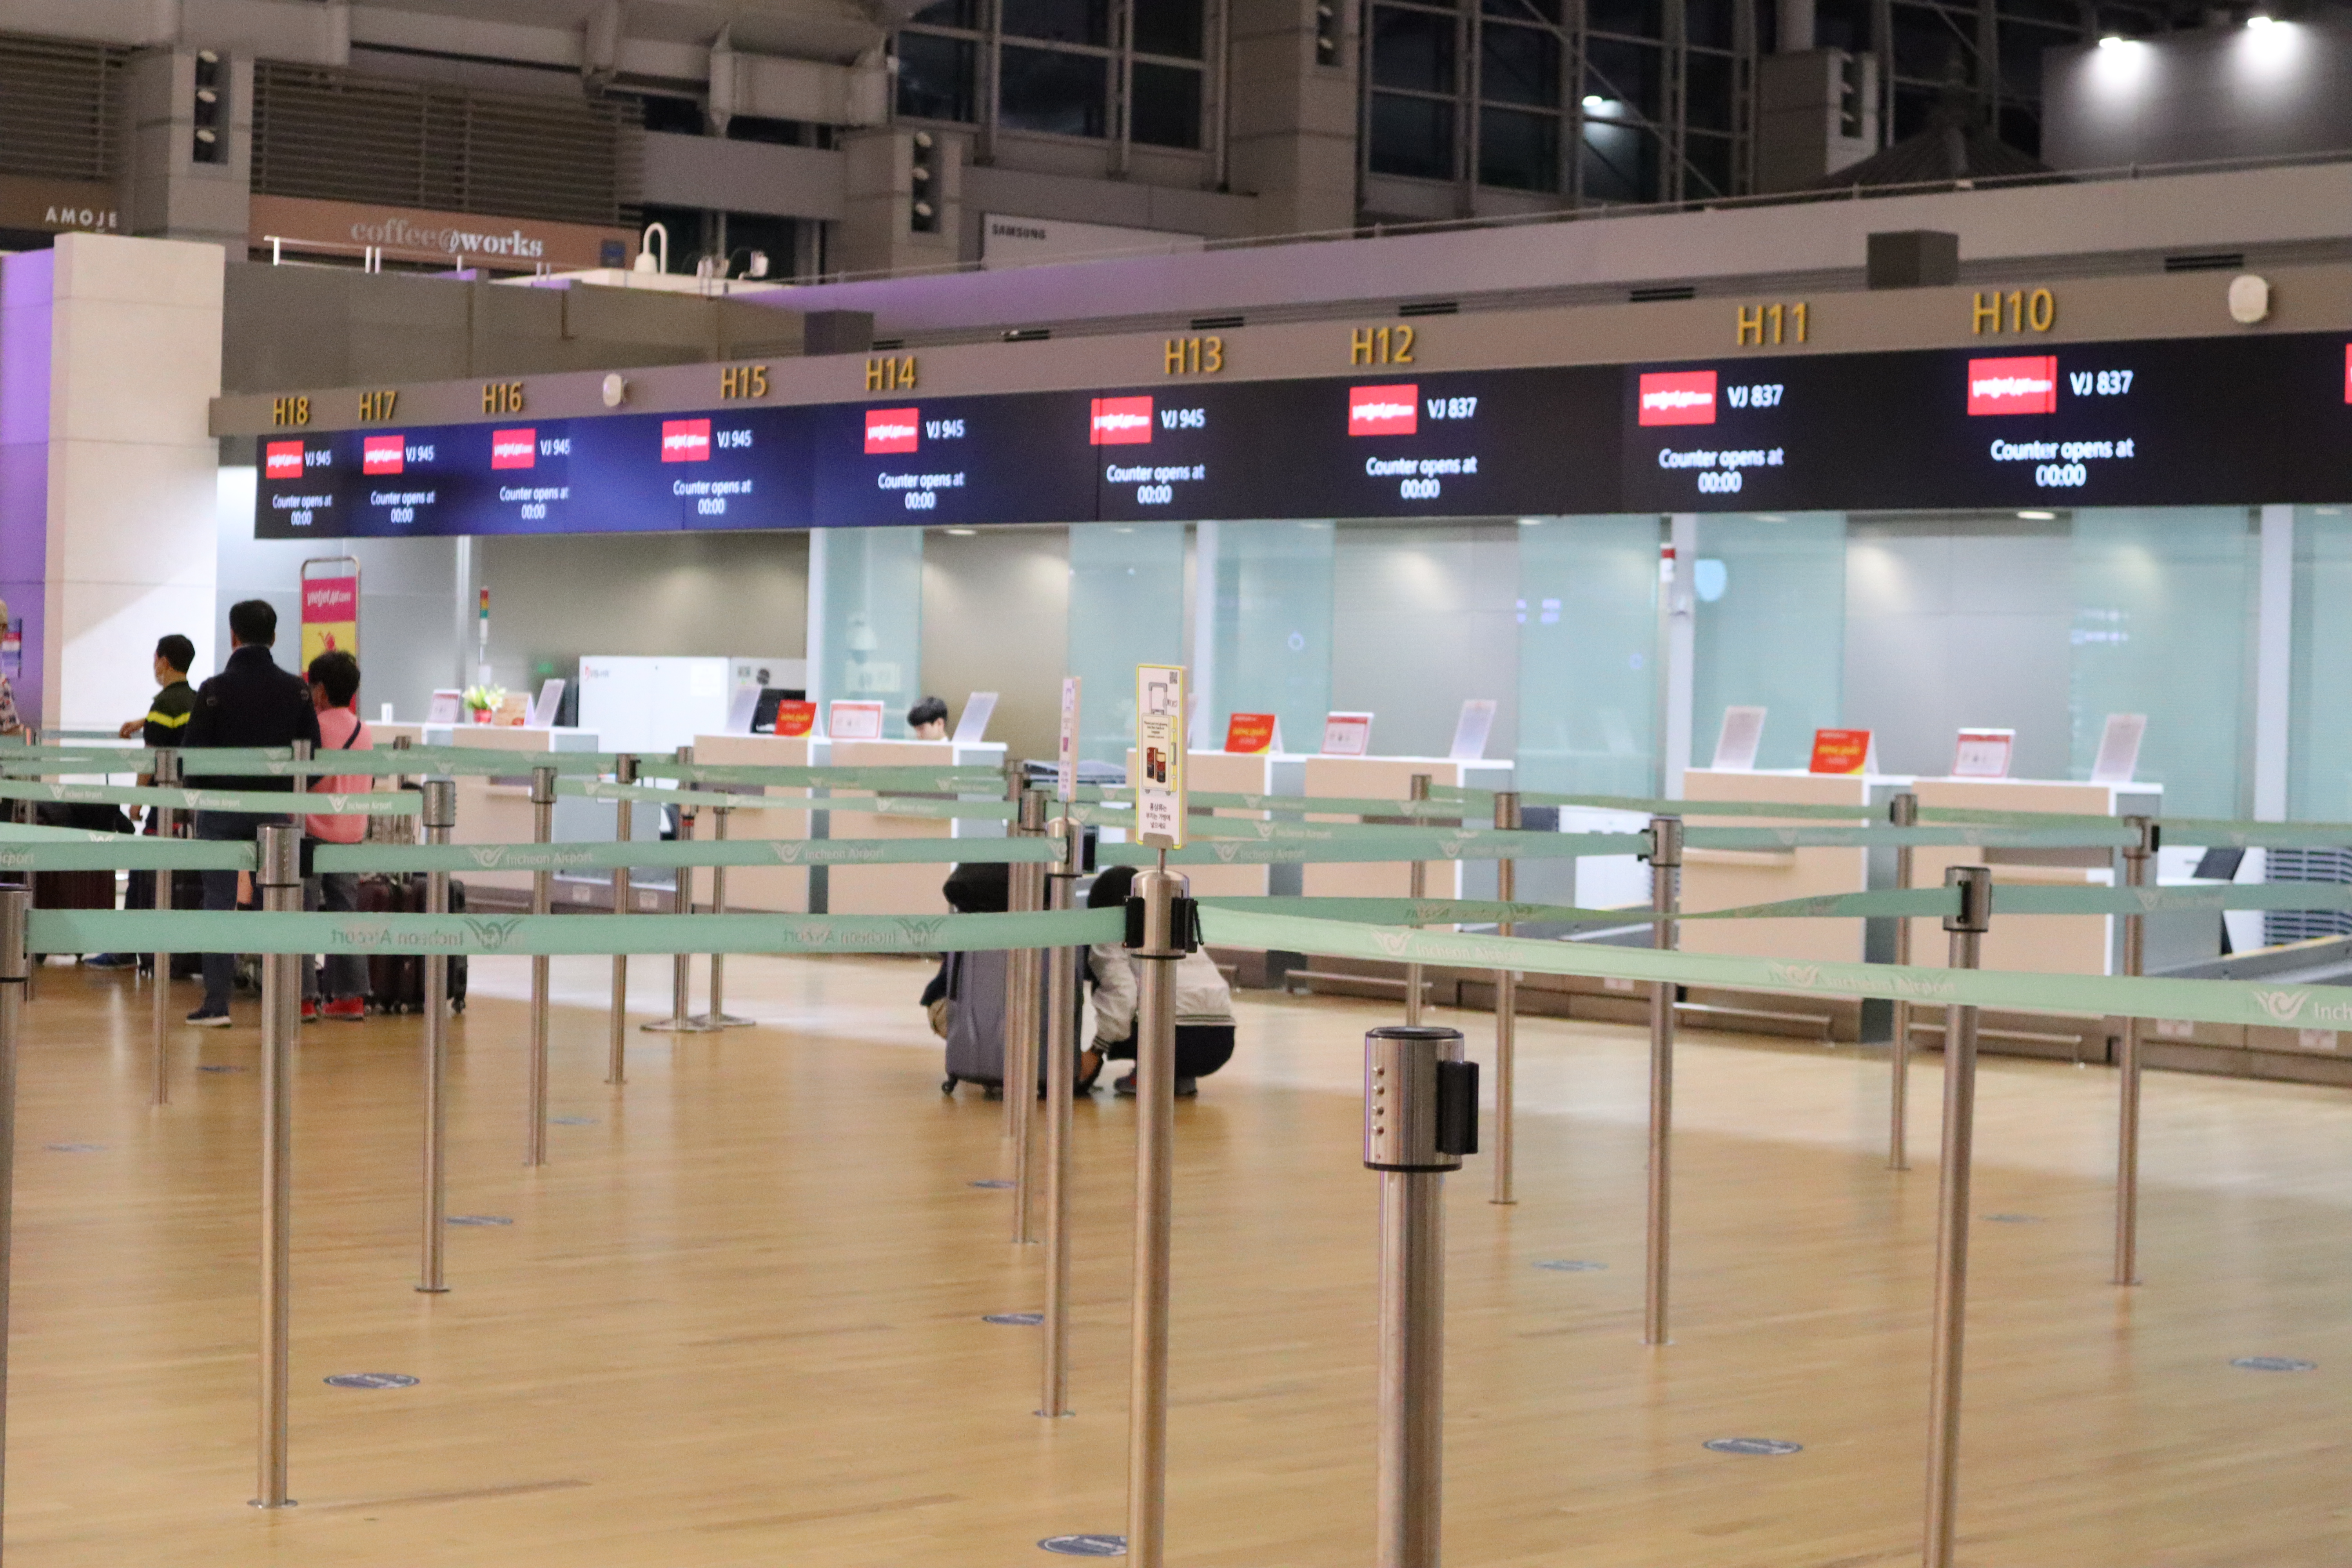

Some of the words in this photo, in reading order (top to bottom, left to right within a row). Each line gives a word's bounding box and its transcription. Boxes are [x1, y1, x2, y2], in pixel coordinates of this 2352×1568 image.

[45, 206, 117, 228] AMOJE
[1974, 289, 2053, 333] H10
[1739, 302, 1808, 344] H11
[1352, 325, 1413, 363] H12
[1165, 337, 1221, 373] H13
[721, 366, 767, 397] H15
[866, 356, 915, 389] H14
[2070, 372, 2092, 395] VJ
[2097, 371, 2132, 394] 837
[359, 391, 396, 419] H17
[483, 383, 522, 412] H16
[1728, 387, 1748, 407] VJ
[1751, 385, 1783, 406] 837
[274, 397, 308, 424] H18
[1428, 399, 1445, 418] VJ
[1448, 397, 1477, 418] 837
[1161, 410, 1177, 428] VJ
[1180, 409, 1204, 428] 945
[926, 421, 940, 438] VJ
[942, 420, 964, 438] 945
[541, 441, 552, 455] VJ
[554, 439, 570, 455] 945
[717, 432, 730, 447] VJ
[732, 430, 751, 447] 945
[305, 452, 315, 466] VJ
[316, 451, 331, 466] 945
[406, 447, 416, 461] VJ
[417, 446, 434, 461] 945
[1659, 449, 1718, 468] Counter
[1719, 450, 1765, 470] opens
[1768, 448, 1783, 465] at
[1991, 440, 2058, 460] Counter
[2061, 442, 2112, 463] opens
[2116, 439, 2134, 457] at
[1107, 465, 1152, 481] Counter
[1154, 467, 1190, 483] opens
[1192, 465, 1204, 479] at
[1366, 457, 1418, 475] Counter
[1420, 459, 1461, 477] opens
[1463, 457, 1477, 473] at
[2036, 464, 2086, 486] 00:00
[673, 481, 710, 495] Counter
[711, 482, 740, 497] opens
[741, 480, 751, 492] at
[878, 473, 918, 488] Counter
[920, 474, 952, 490] opens
[953, 472, 964, 486] at
[1401, 479, 1439, 498] 00:00
[1699, 472, 1741, 492] 00:00
[273, 495, 300, 508] Counter
[301, 496, 323, 510] opens
[324, 495, 332, 506] at
[371, 492, 401, 505] Counter
[402, 493, 425, 507] opens
[426, 492, 435, 503] at
[500, 487, 532, 500] Counter
[534, 488, 559, 503] opens
[559, 488, 568, 499] at
[905, 492, 935, 508] 00:00
[1138, 485, 1171, 503] 00:00
[391, 508, 413, 522] 00:00
[522, 504, 545, 519] 00:00
[698, 498, 725, 514] 00:00
[291, 511, 312, 525] 00:00
[347, 802, 369, 810] Incheon
[371, 801, 393, 811] Airport
[1150, 802, 1167, 812] 홍삼류는
[506, 854, 550, 865] Incheon
[553, 852, 593, 865] Airport
[806, 848, 846, 860] Incheon
